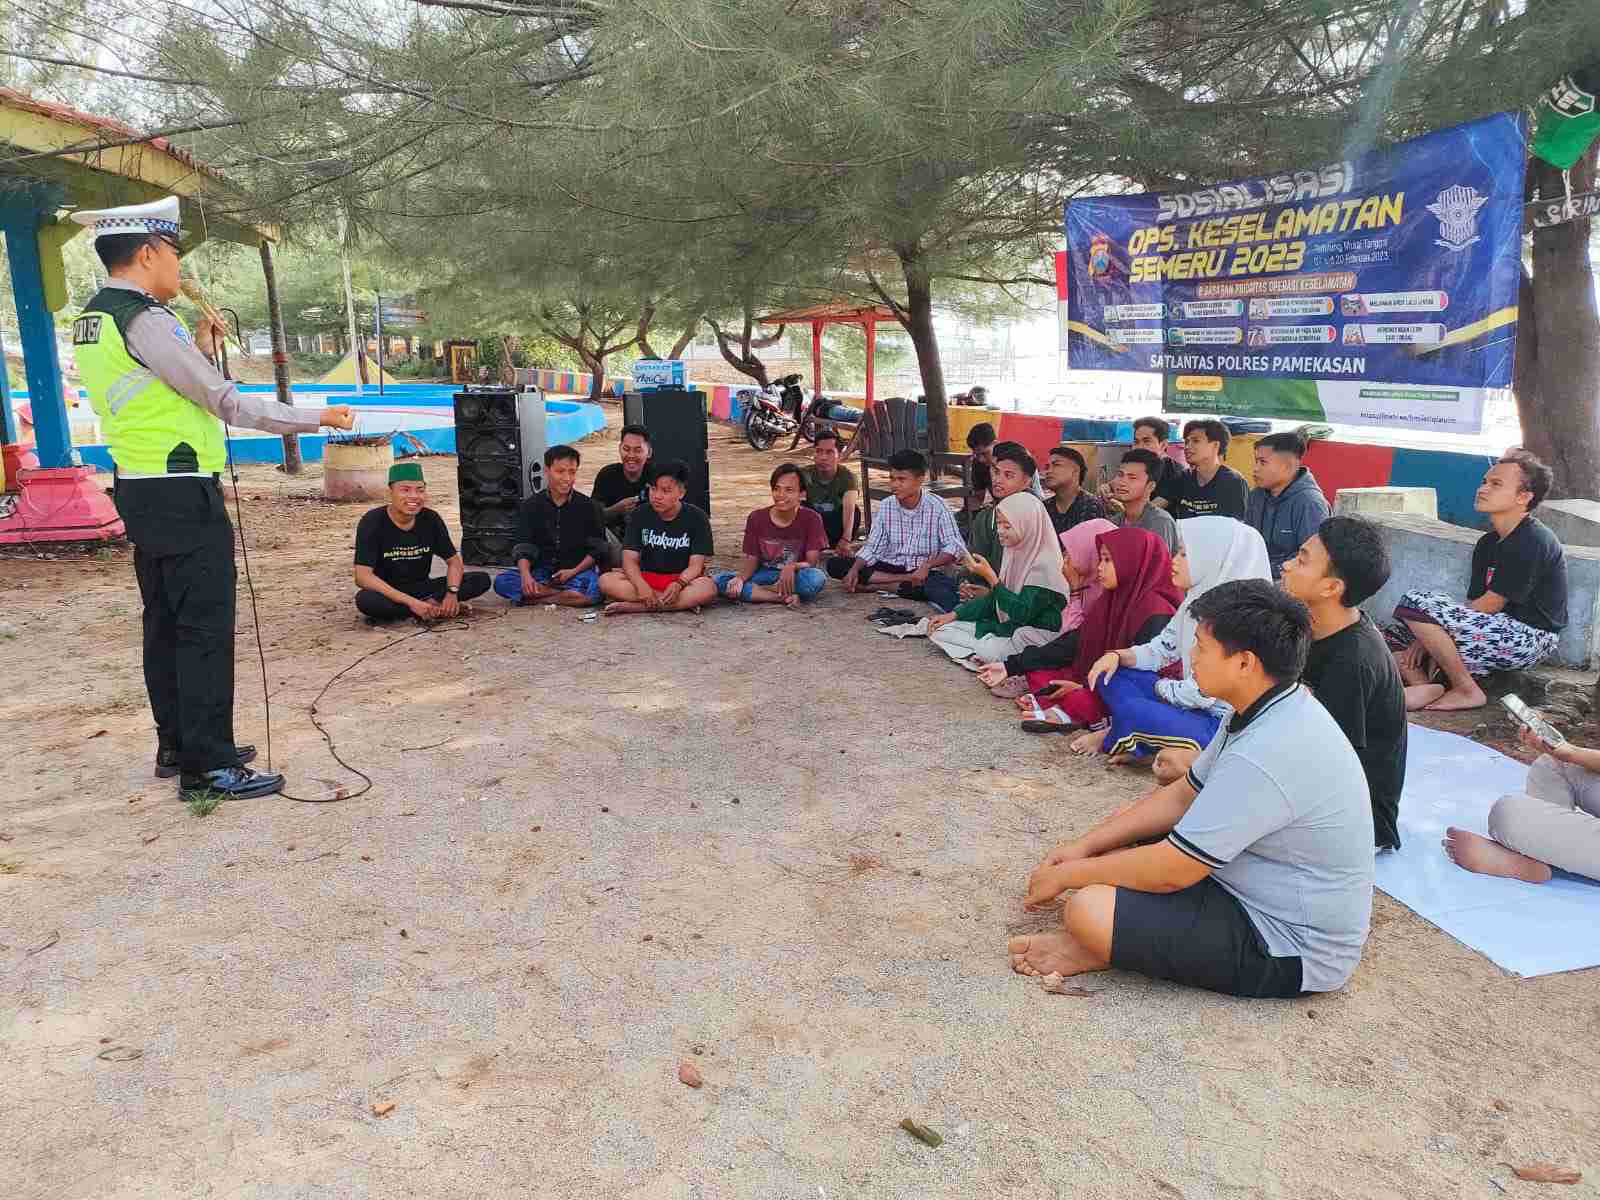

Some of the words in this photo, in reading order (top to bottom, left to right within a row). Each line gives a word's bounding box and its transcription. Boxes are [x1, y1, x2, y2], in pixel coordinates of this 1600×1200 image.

[1128, 222, 1179, 256] OPS.
[1188, 191, 1404, 249] KESELAMATAN
[1128, 248, 1221, 284] SEMERU
[1230, 239, 1306, 276] 2023
[1150, 353, 1214, 370] SATLANTAS
[1217, 354, 1268, 372] POLRES
[1272, 355, 1366, 374] PAMEKASAN
